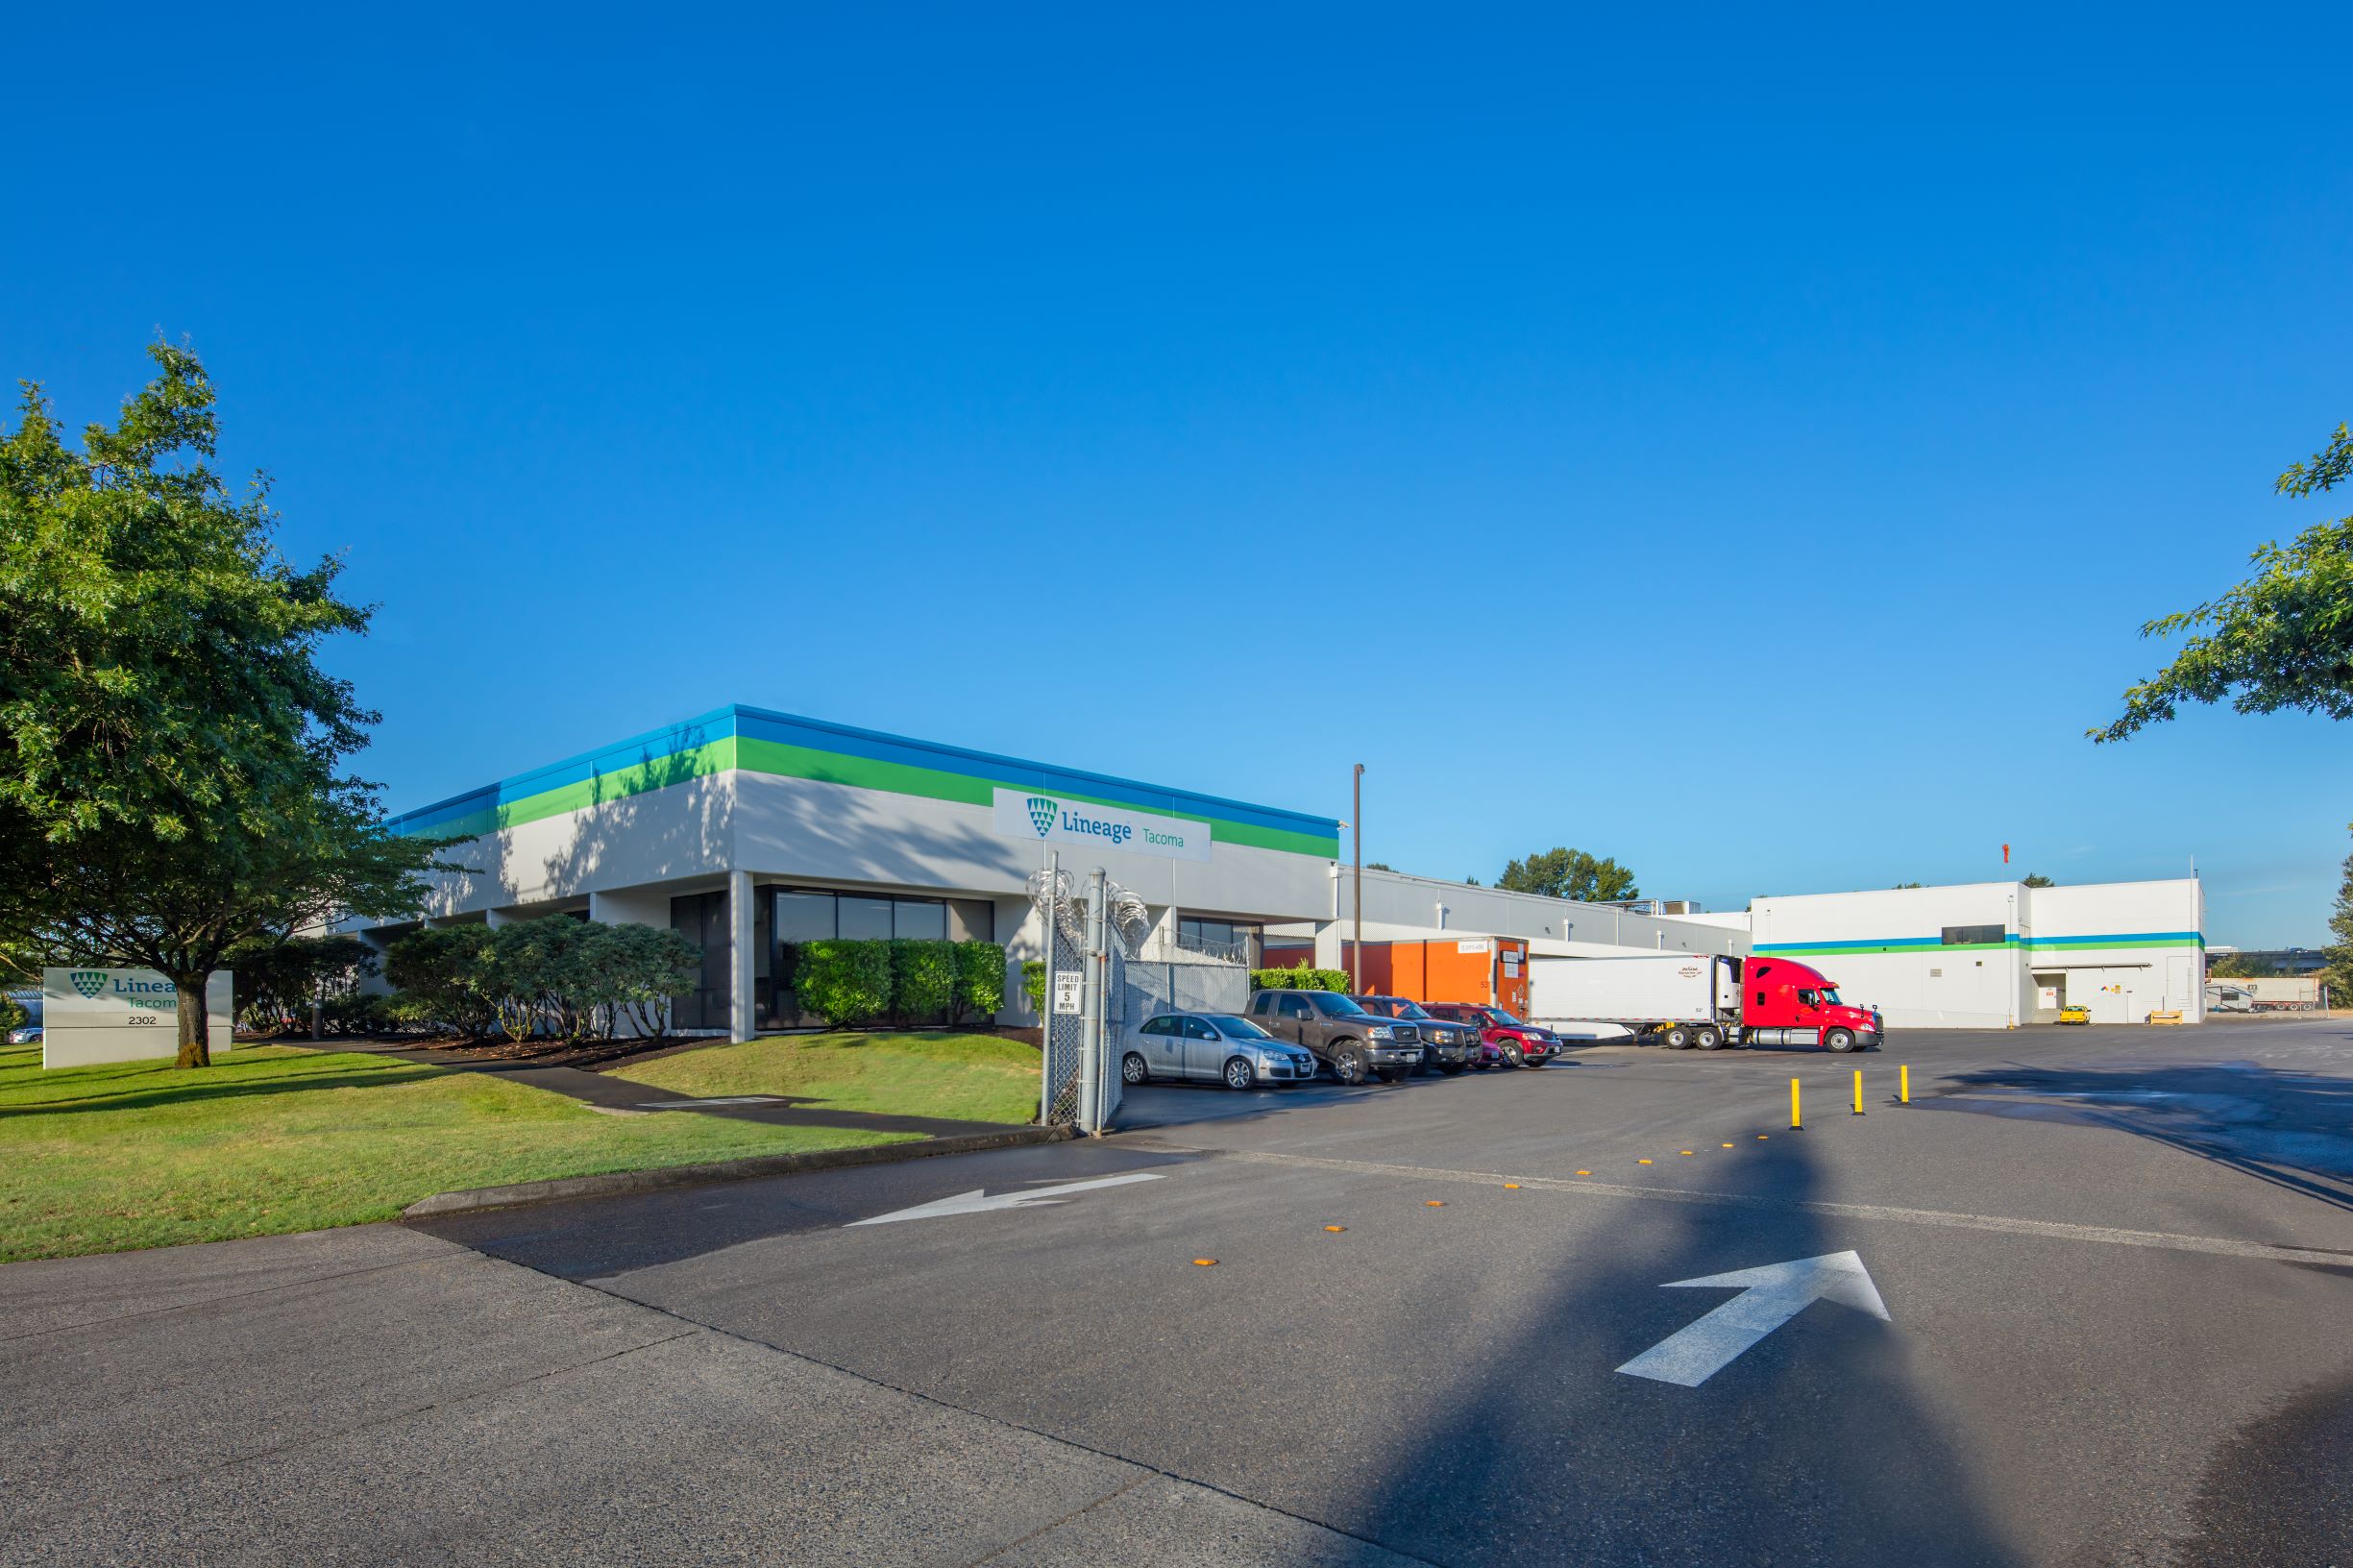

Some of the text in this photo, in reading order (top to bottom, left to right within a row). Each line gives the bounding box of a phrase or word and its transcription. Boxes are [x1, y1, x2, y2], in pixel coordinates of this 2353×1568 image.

[1062, 811, 1184, 847] Lineage Tacoma
[113, 978, 177, 993] Linea
[1065, 992, 1070, 1001] 5
[128, 997, 177, 1009] Tacom
[128, 1017, 157, 1025] 2302
